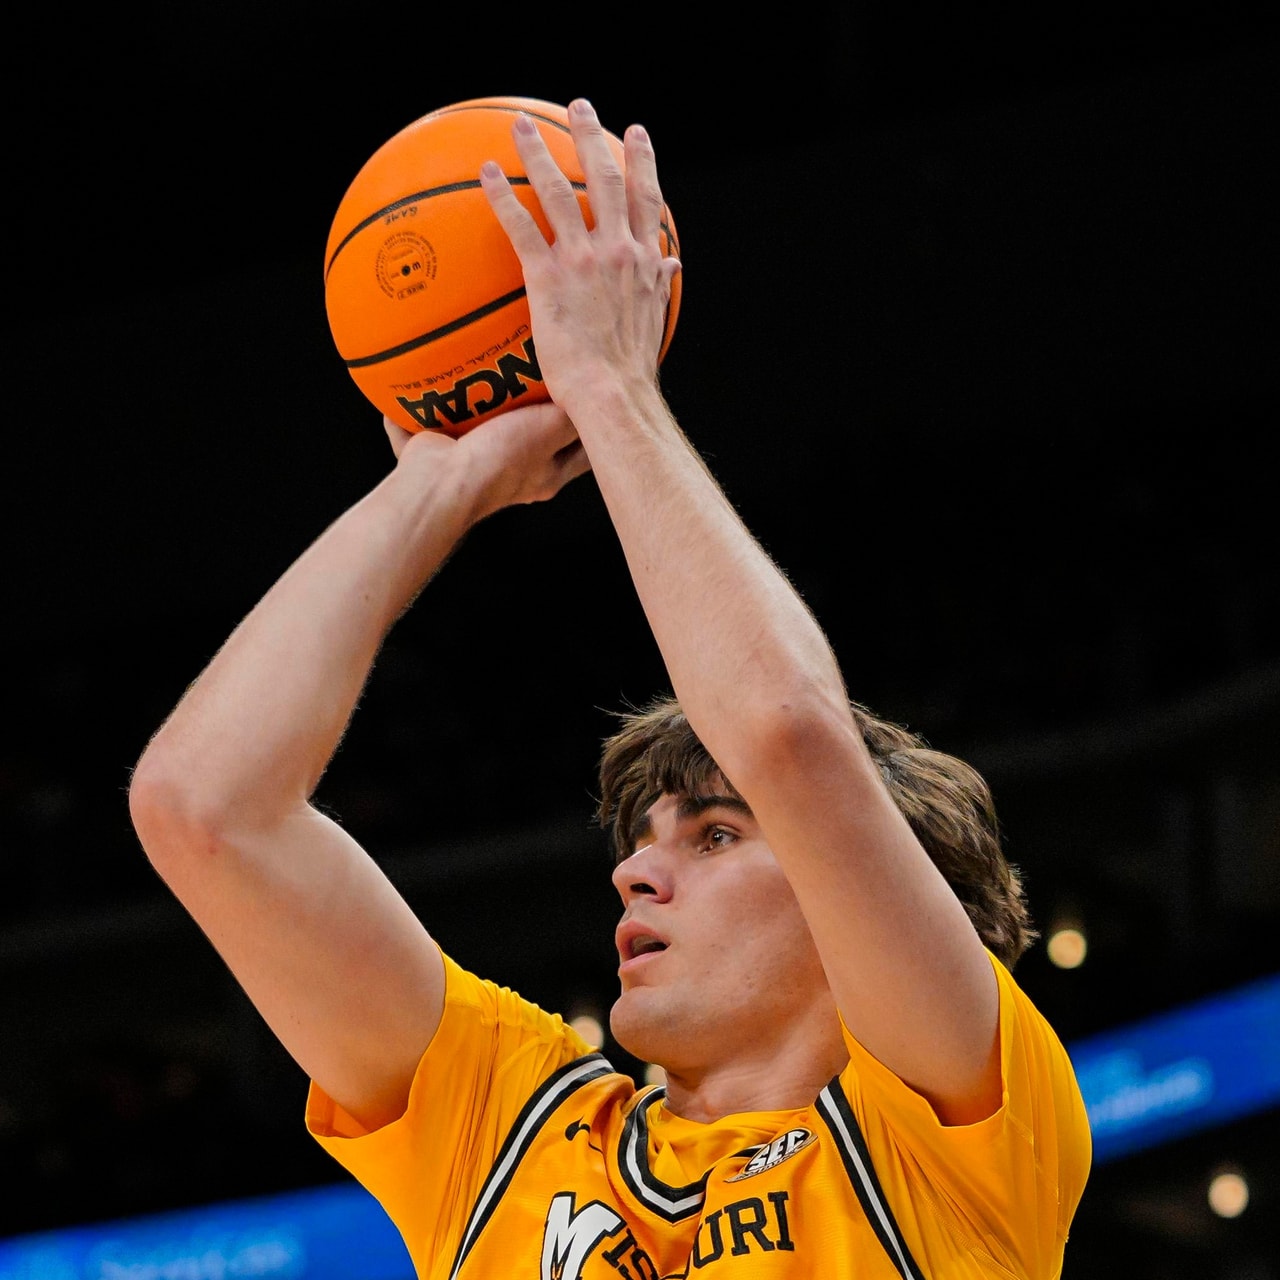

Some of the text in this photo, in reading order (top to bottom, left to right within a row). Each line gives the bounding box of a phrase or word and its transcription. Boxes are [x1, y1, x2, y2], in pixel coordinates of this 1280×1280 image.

[388, 323, 529, 391] OFFICIAL GAME BALL
[395, 337, 544, 428] NCAA
[746, 1129, 807, 1172] SEC
